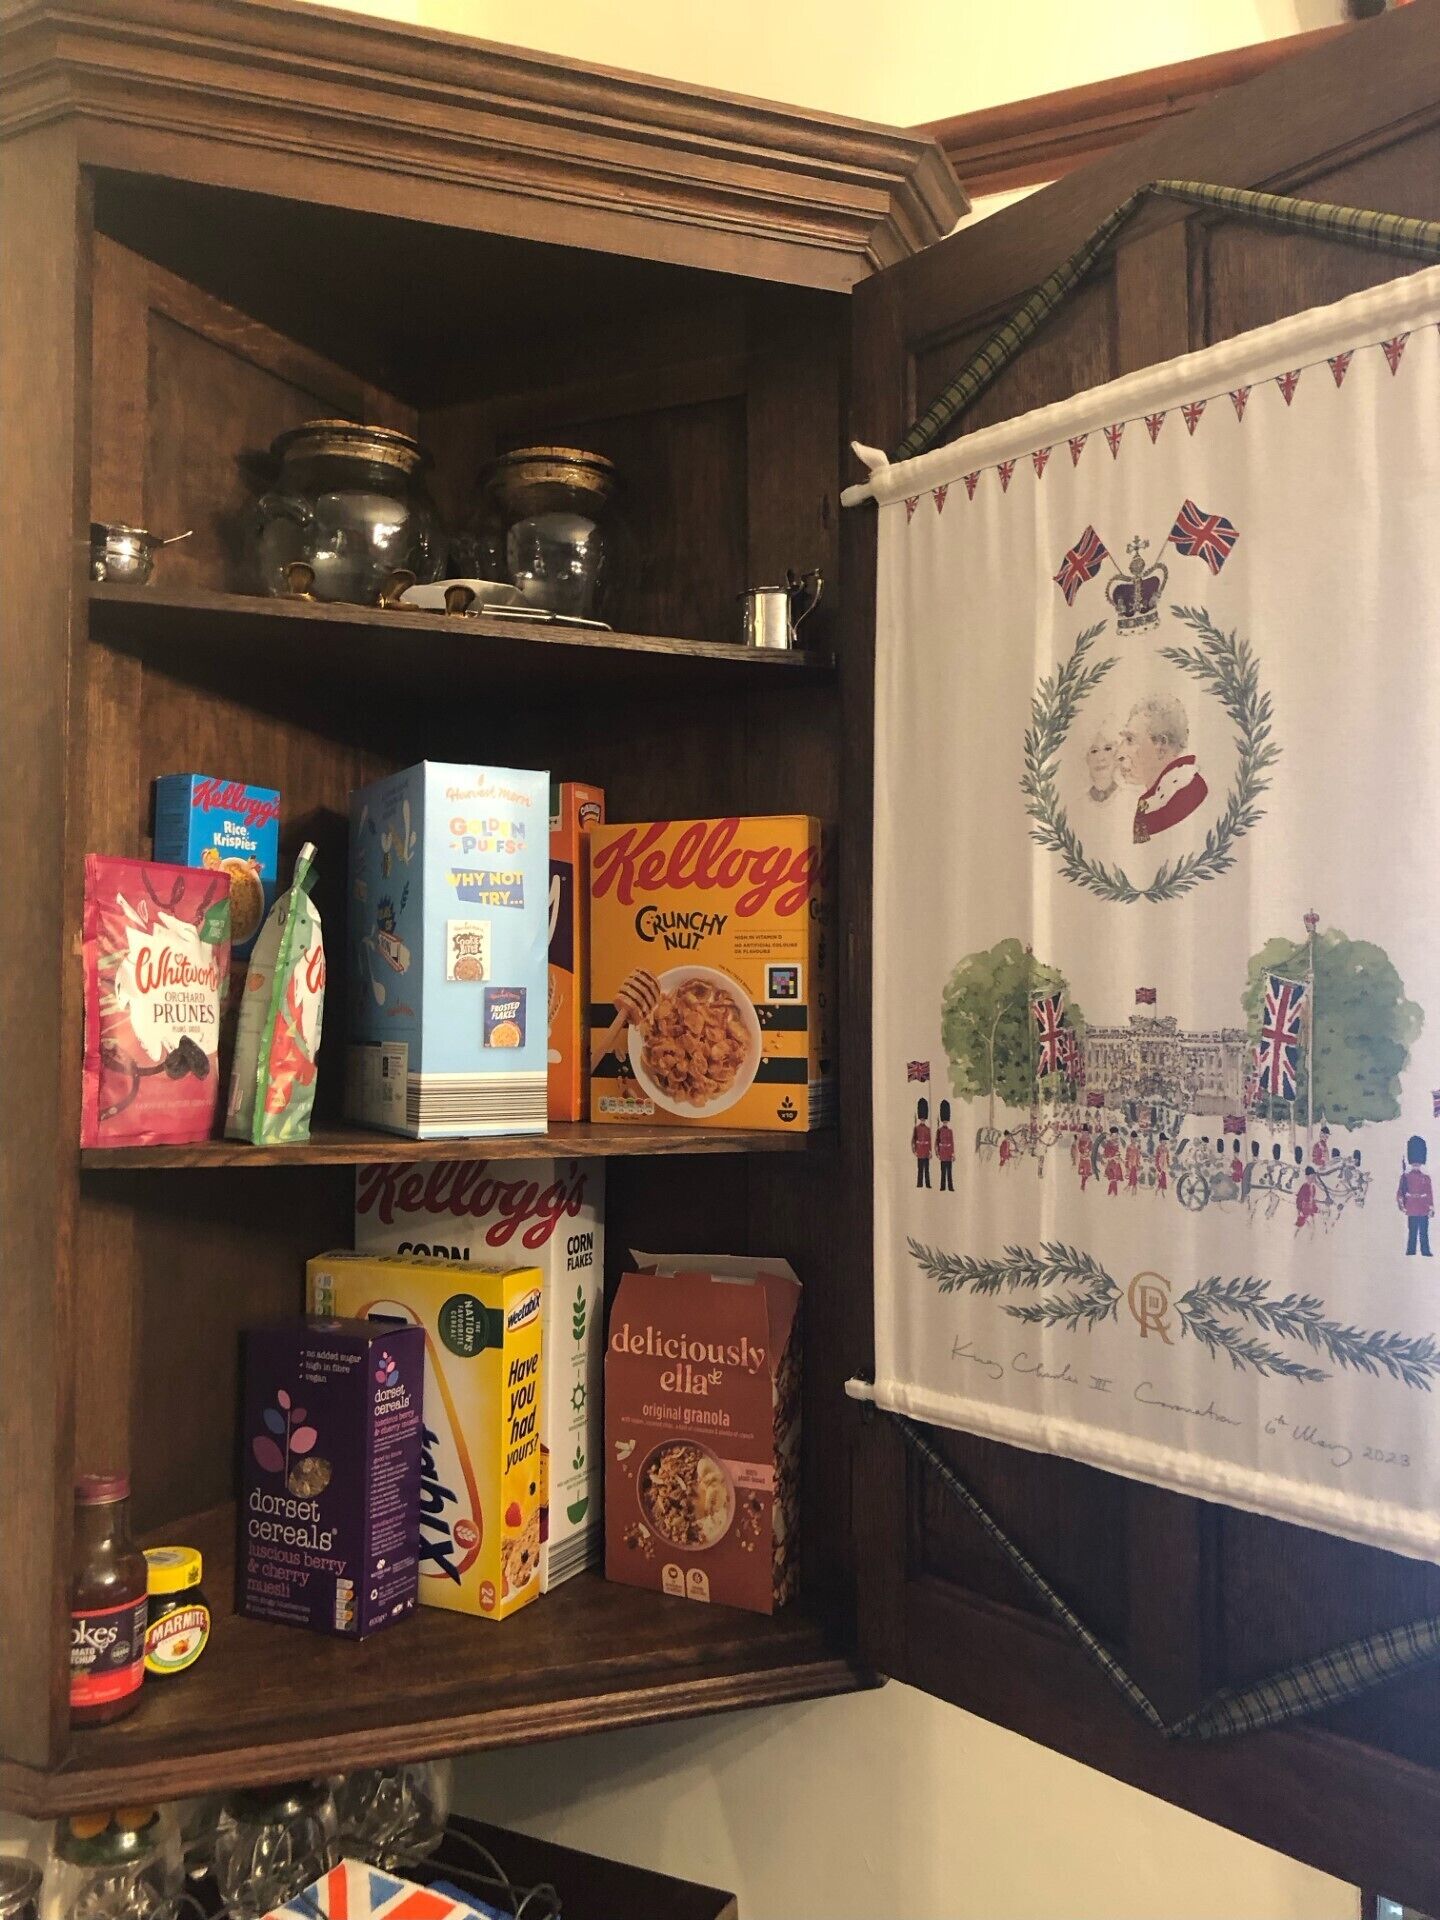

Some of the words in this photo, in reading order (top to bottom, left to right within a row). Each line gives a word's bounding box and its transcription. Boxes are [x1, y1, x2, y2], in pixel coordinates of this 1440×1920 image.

[223, 820, 248, 836] Rice
[213, 832, 258, 851] Krispies
[446, 869, 485, 887] WHY
[489, 870, 524, 887] NOT
[635, 905, 728, 943] CRUNCHY
[664, 932, 705, 951] NUT
[164, 991, 206, 1003] ORCHARD
[490, 1001, 521, 1013] FROSTED
[153, 1003, 216, 1024] PRUNES
[490, 1009, 517, 1020] FLAKES
[567, 1231, 593, 1256] CORN
[566, 1252, 593, 1272] FLAKES
[464, 1300, 475, 1352] NATION'S
[306, 1350, 316, 1358] no
[316, 1350, 339, 1361] added
[340, 1354, 362, 1364] sugar
[611, 1323, 766, 1375] deliciously
[305, 1361, 322, 1371] high
[323, 1363, 331, 1371] in
[332, 1363, 350, 1373] fibre
[508, 1353, 538, 1388] Have
[305, 1374, 327, 1383] vegan
[660, 1362, 709, 1396] ella
[374, 1384, 406, 1403] dorset
[510, 1380, 535, 1419] you
[374, 1395, 411, 1417] cereals
[642, 1402, 682, 1421] original
[684, 1408, 730, 1427] granola
[509, 1411, 536, 1445] had
[504, 1432, 539, 1475] yours?
[1362, 1445, 1411, 1468] 2023
[249, 1487, 321, 1523] dorset
[248, 1518, 333, 1552] cereals
[248, 1541, 300, 1566] luscious
[303, 1551, 347, 1576] berry
[247, 1558, 259, 1573] &
[262, 1562, 310, 1587] cherry
[247, 1578, 291, 1598] muesli
[481, 1586, 494, 1605] 24
[71, 1619, 118, 1654] okes
[151, 1611, 204, 1644] MARMITE
[71, 1647, 96, 1656] MATO
